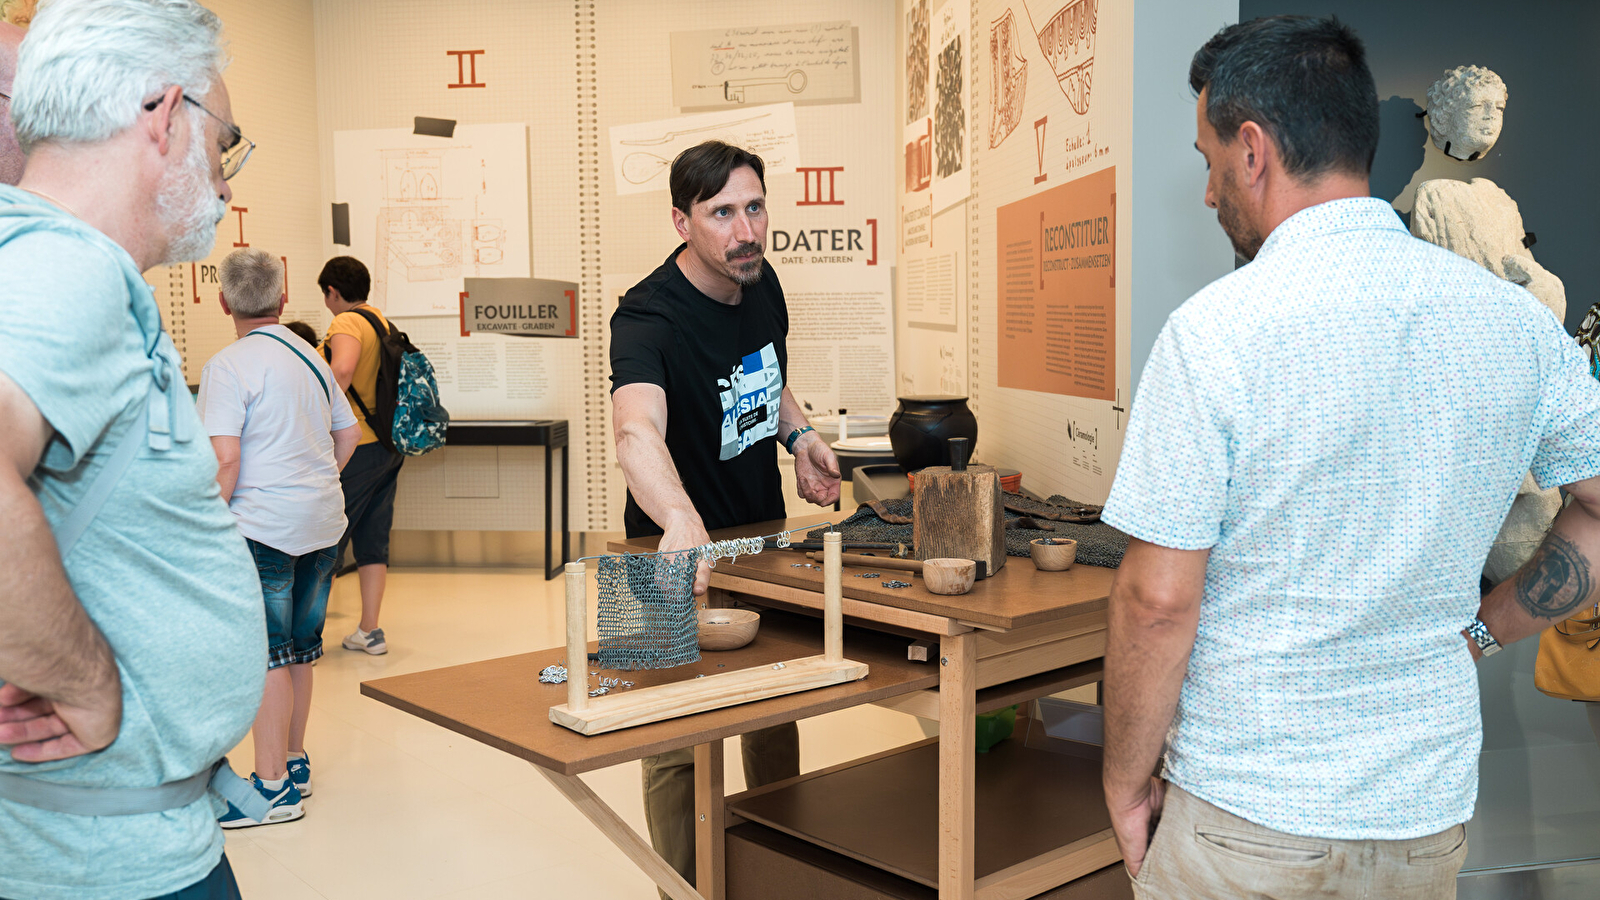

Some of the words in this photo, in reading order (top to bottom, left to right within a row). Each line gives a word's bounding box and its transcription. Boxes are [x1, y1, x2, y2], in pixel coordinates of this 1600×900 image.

[446, 49, 486, 89] II
[795, 166, 844, 206] III
[772, 229, 864, 252] DATER
[1044, 216, 1109, 252] RECONSTITUER
[781, 256, 804, 264] DATE
[475, 304, 559, 320] FOUILLER
[477, 323, 517, 331] EXCAVATE
[522, 322, 555, 330] GRABEN
